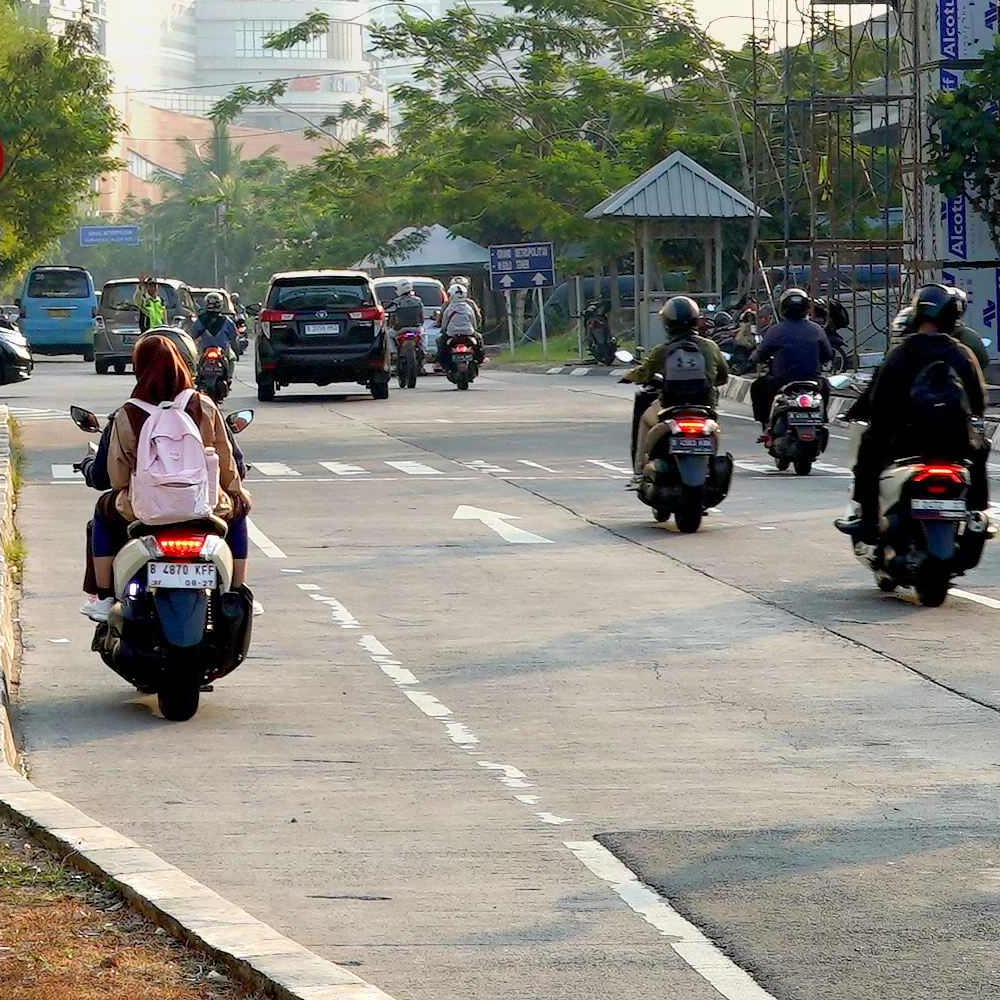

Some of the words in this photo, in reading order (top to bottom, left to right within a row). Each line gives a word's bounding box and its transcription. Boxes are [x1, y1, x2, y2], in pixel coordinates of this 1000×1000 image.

[951, 195, 964, 254] Alcotu
[163, 563, 189, 575] 4870
[194, 564, 215, 576] KFF
